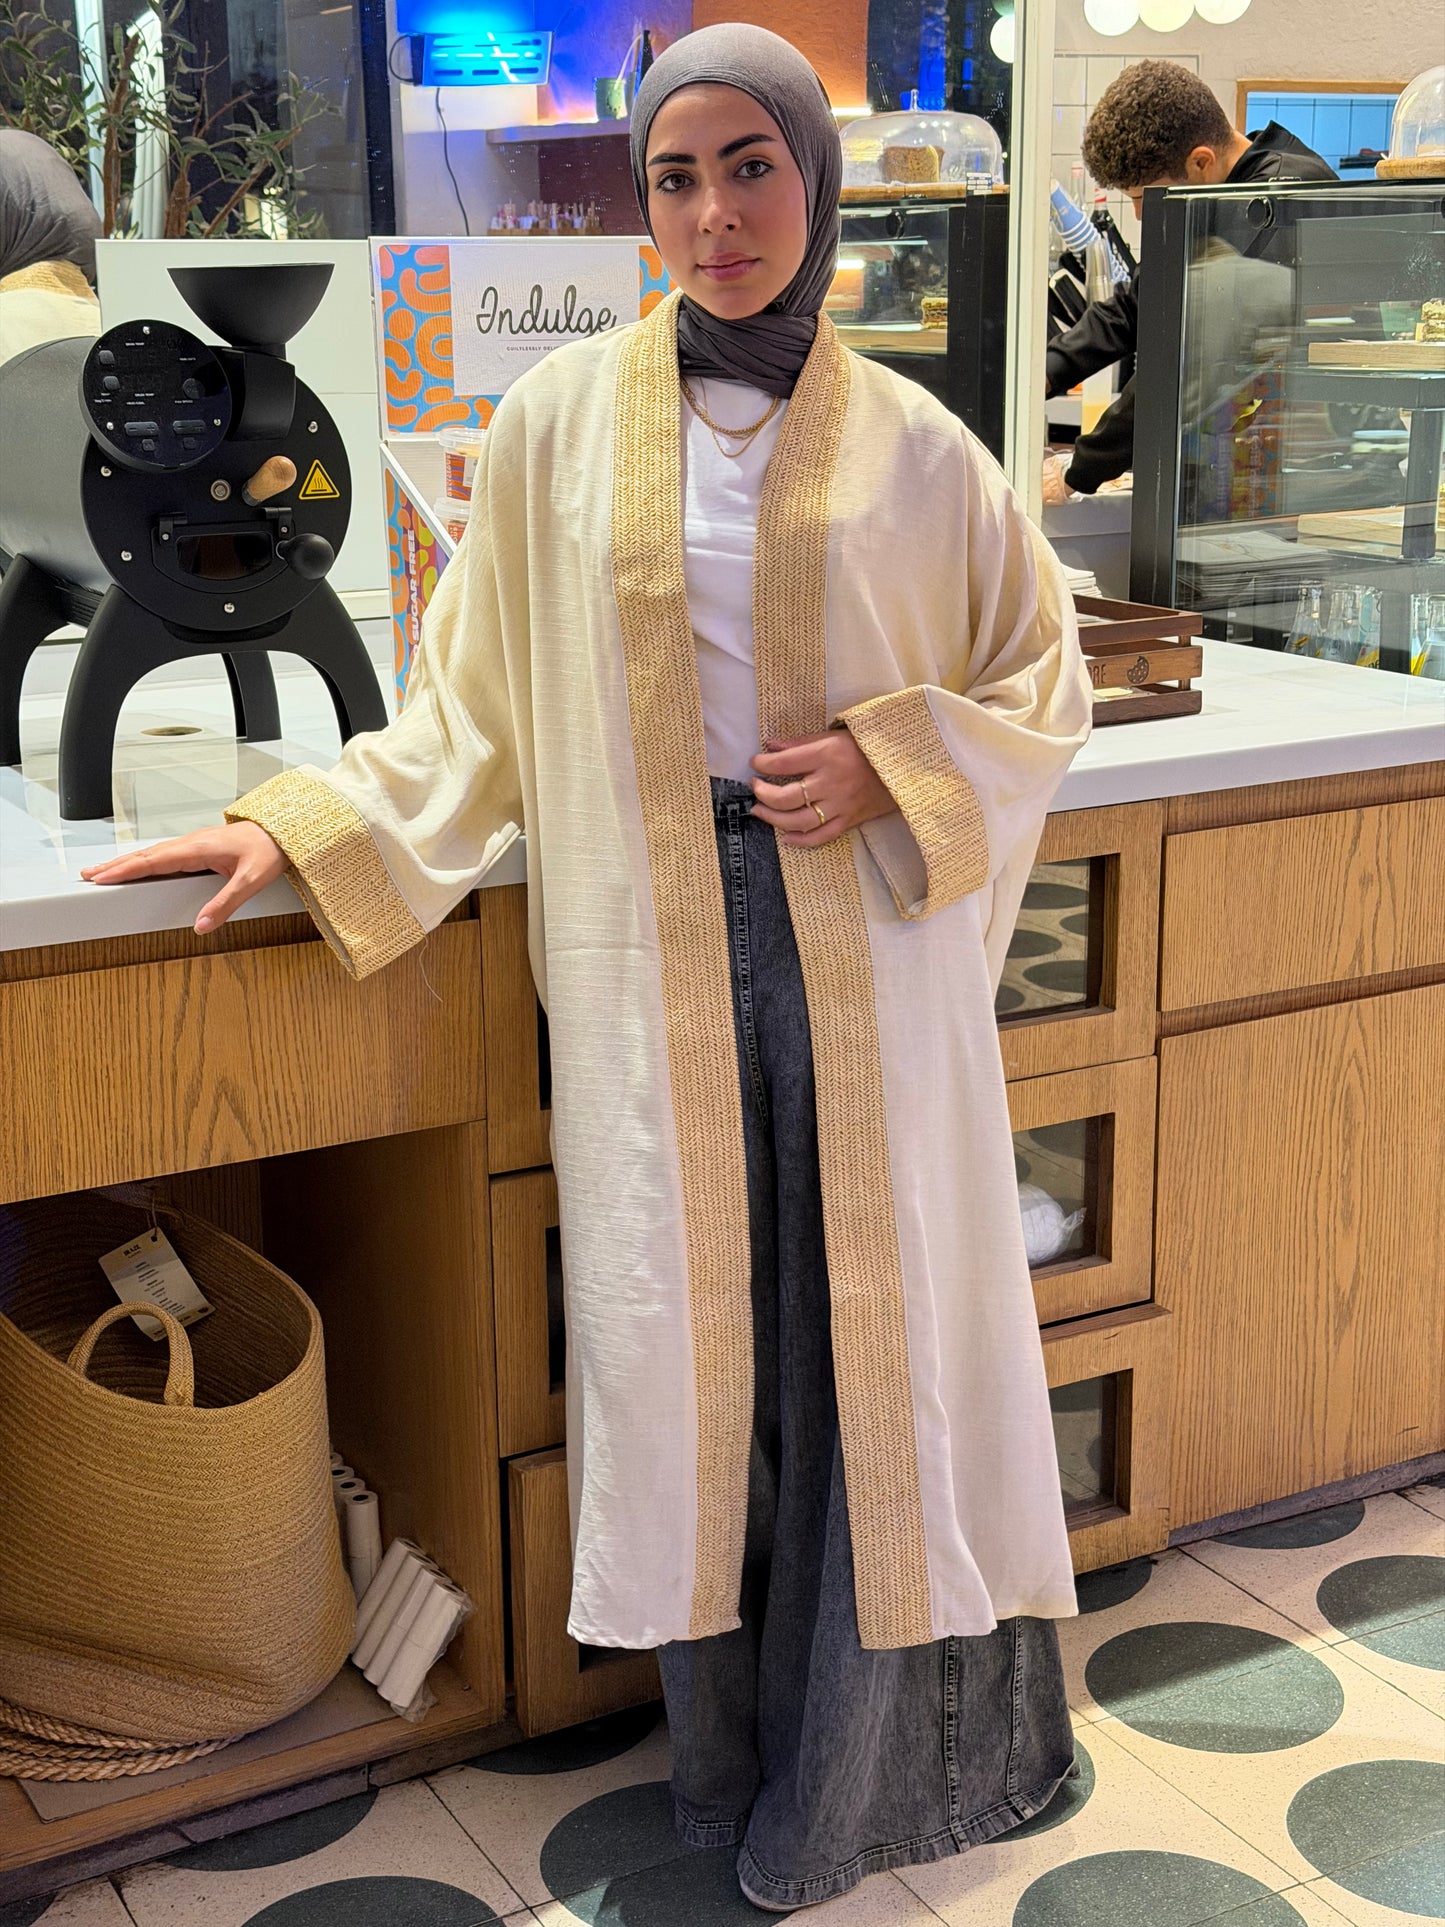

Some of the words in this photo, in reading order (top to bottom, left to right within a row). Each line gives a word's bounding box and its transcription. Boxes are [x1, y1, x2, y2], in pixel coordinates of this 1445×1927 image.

[476, 284, 617, 338] Indulge
[408, 529, 416, 576] FREE
[410, 578, 419, 641] SUGAR
